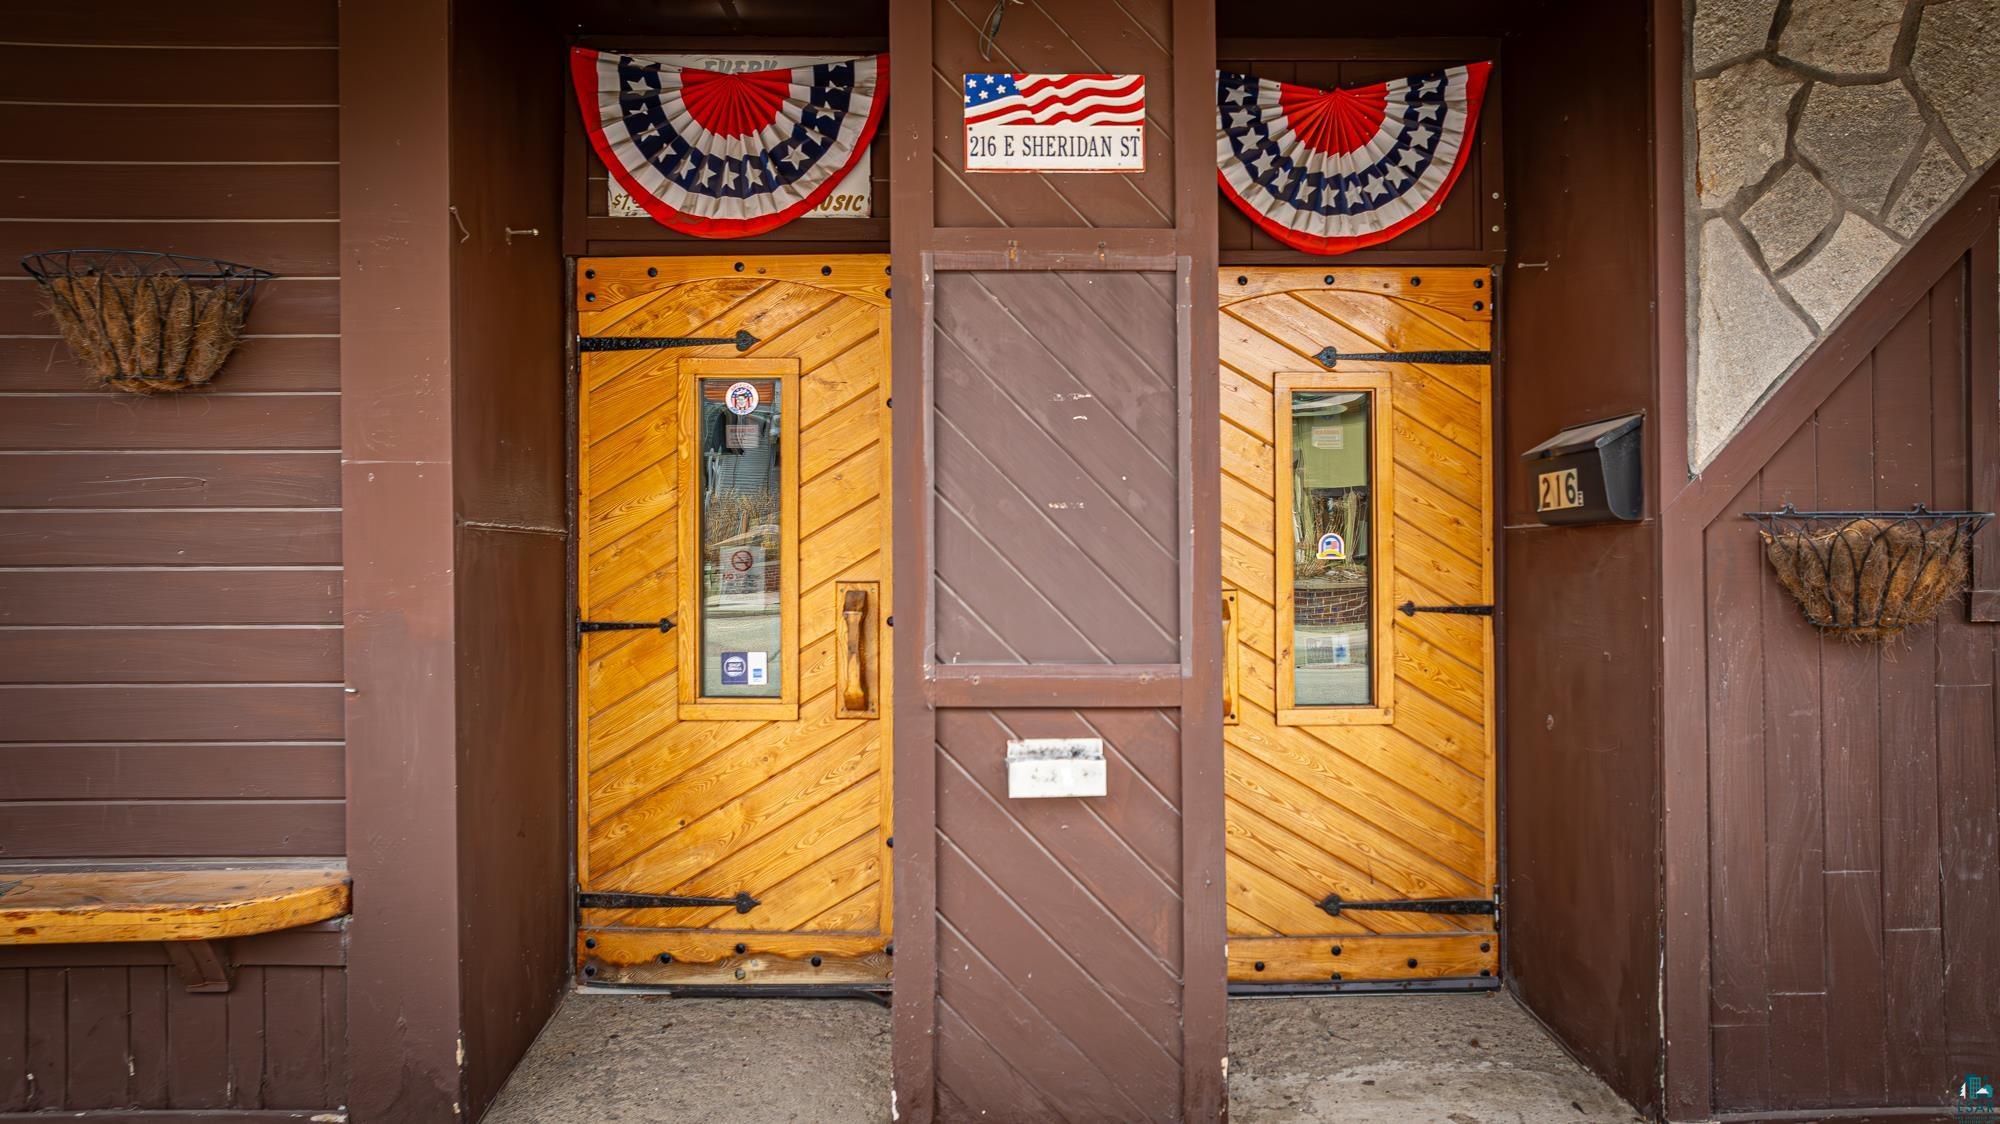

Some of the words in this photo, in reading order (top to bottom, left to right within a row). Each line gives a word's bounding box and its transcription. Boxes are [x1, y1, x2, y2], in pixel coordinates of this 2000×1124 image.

[969, 135, 997, 157] 216
[1004, 135, 1015, 157] E
[1022, 135, 1113, 157] SHERIDAN
[1120, 135, 1141, 157] ST
[814, 194, 865, 212] USIC
[1542, 472, 1577, 508] 216
